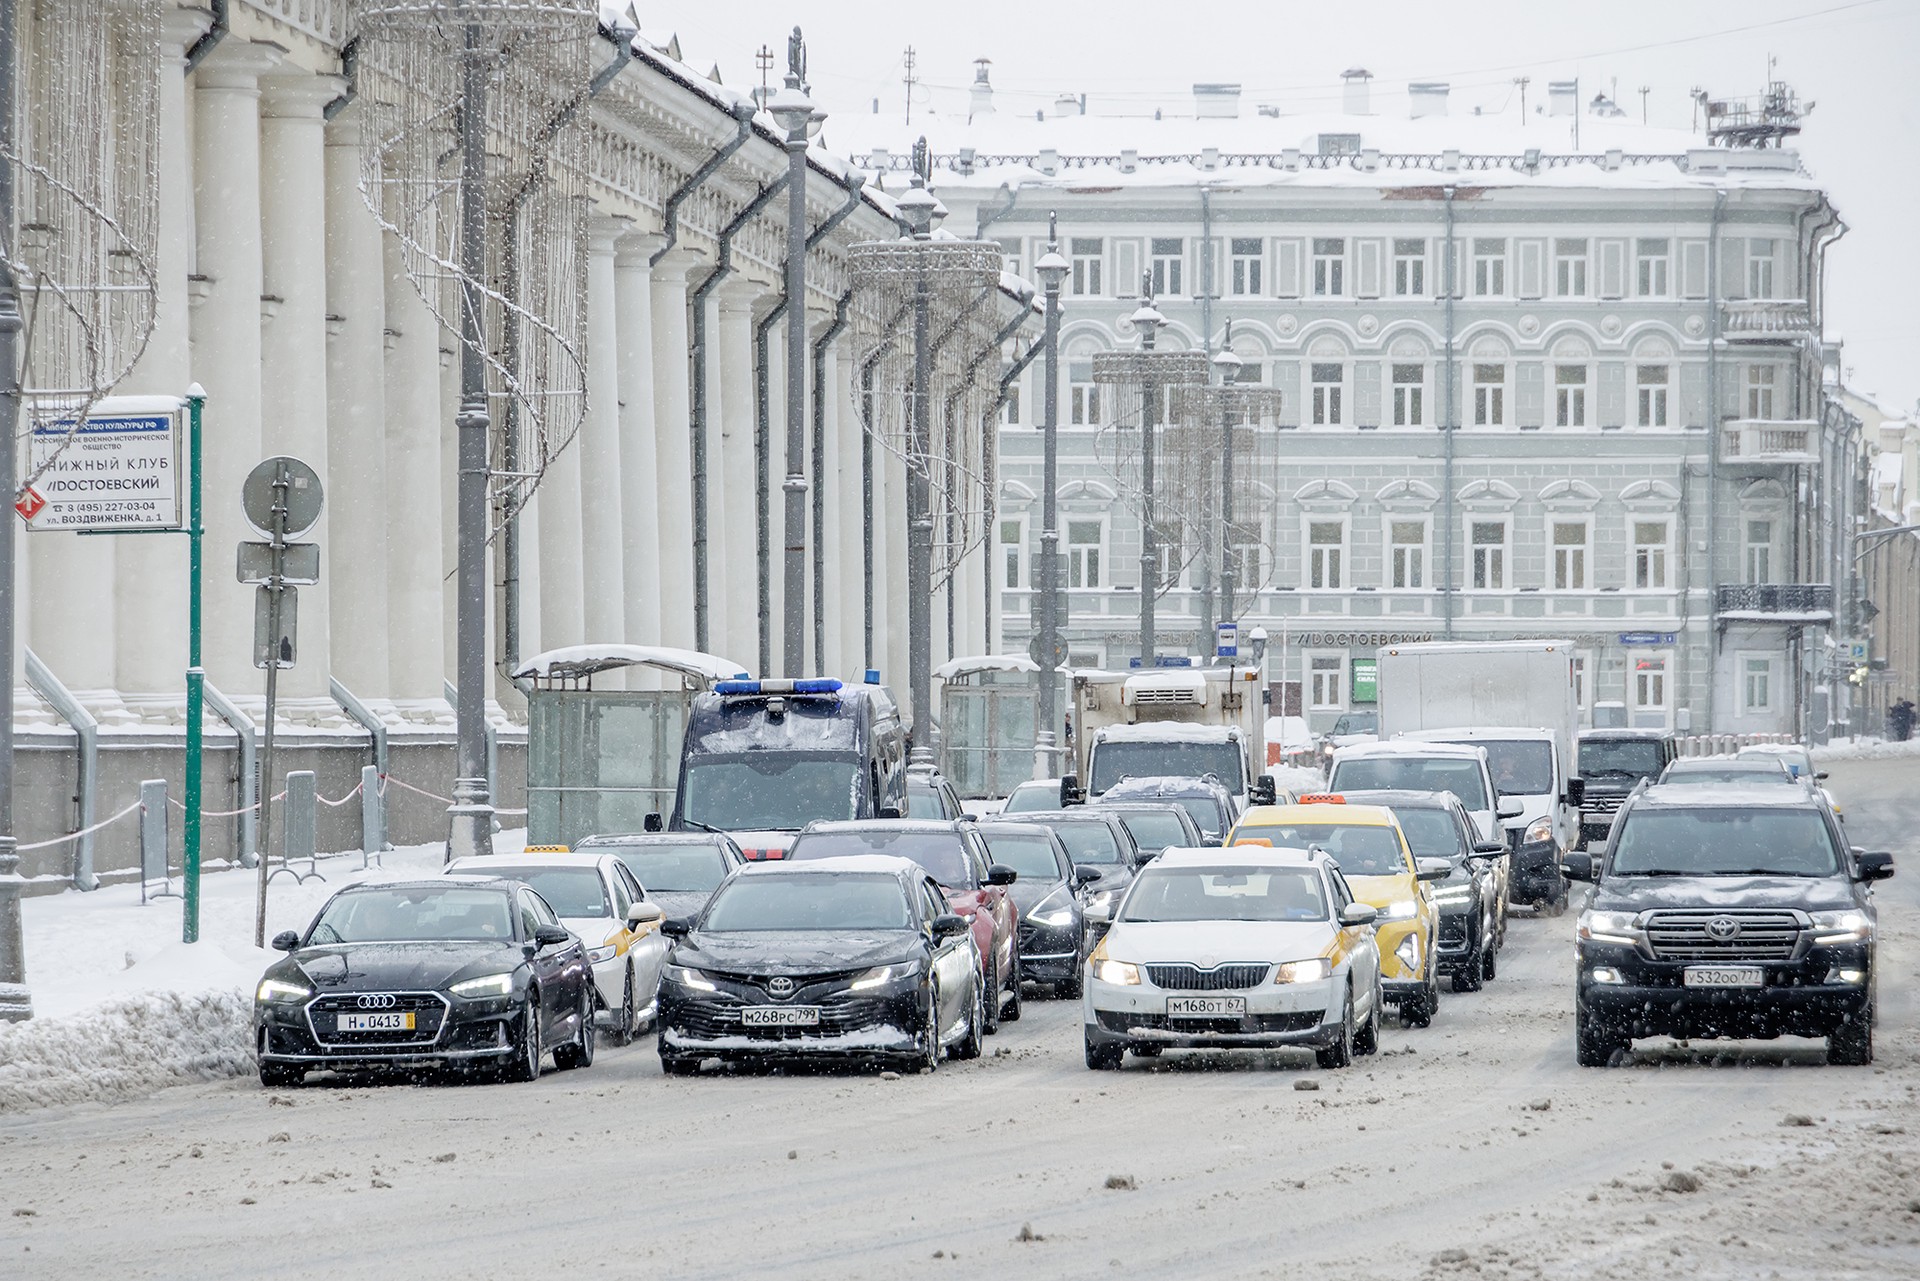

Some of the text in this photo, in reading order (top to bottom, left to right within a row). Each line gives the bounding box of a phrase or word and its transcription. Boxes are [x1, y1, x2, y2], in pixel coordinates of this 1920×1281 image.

[105, 421, 144, 430] КУЛЬТУРЫ
[145, 421, 157, 429] РФ
[83, 434, 170, 443] ВОЕННО-ИСТОРИЧЕСКОЕ
[82, 443, 122, 451] ОБЩЕСТВО
[127, 457, 168, 471] КЛУБ
[67, 502, 156, 513] 8 (495) 227-03-04
[156, 513, 162, 522] 1
[1740, 970, 1760, 980] 777
[1227, 999, 1240, 1009] 67
[797, 1009, 816, 1019] 799
[348, 1016, 357, 1029] H
[368, 1015, 400, 1028] 0413
